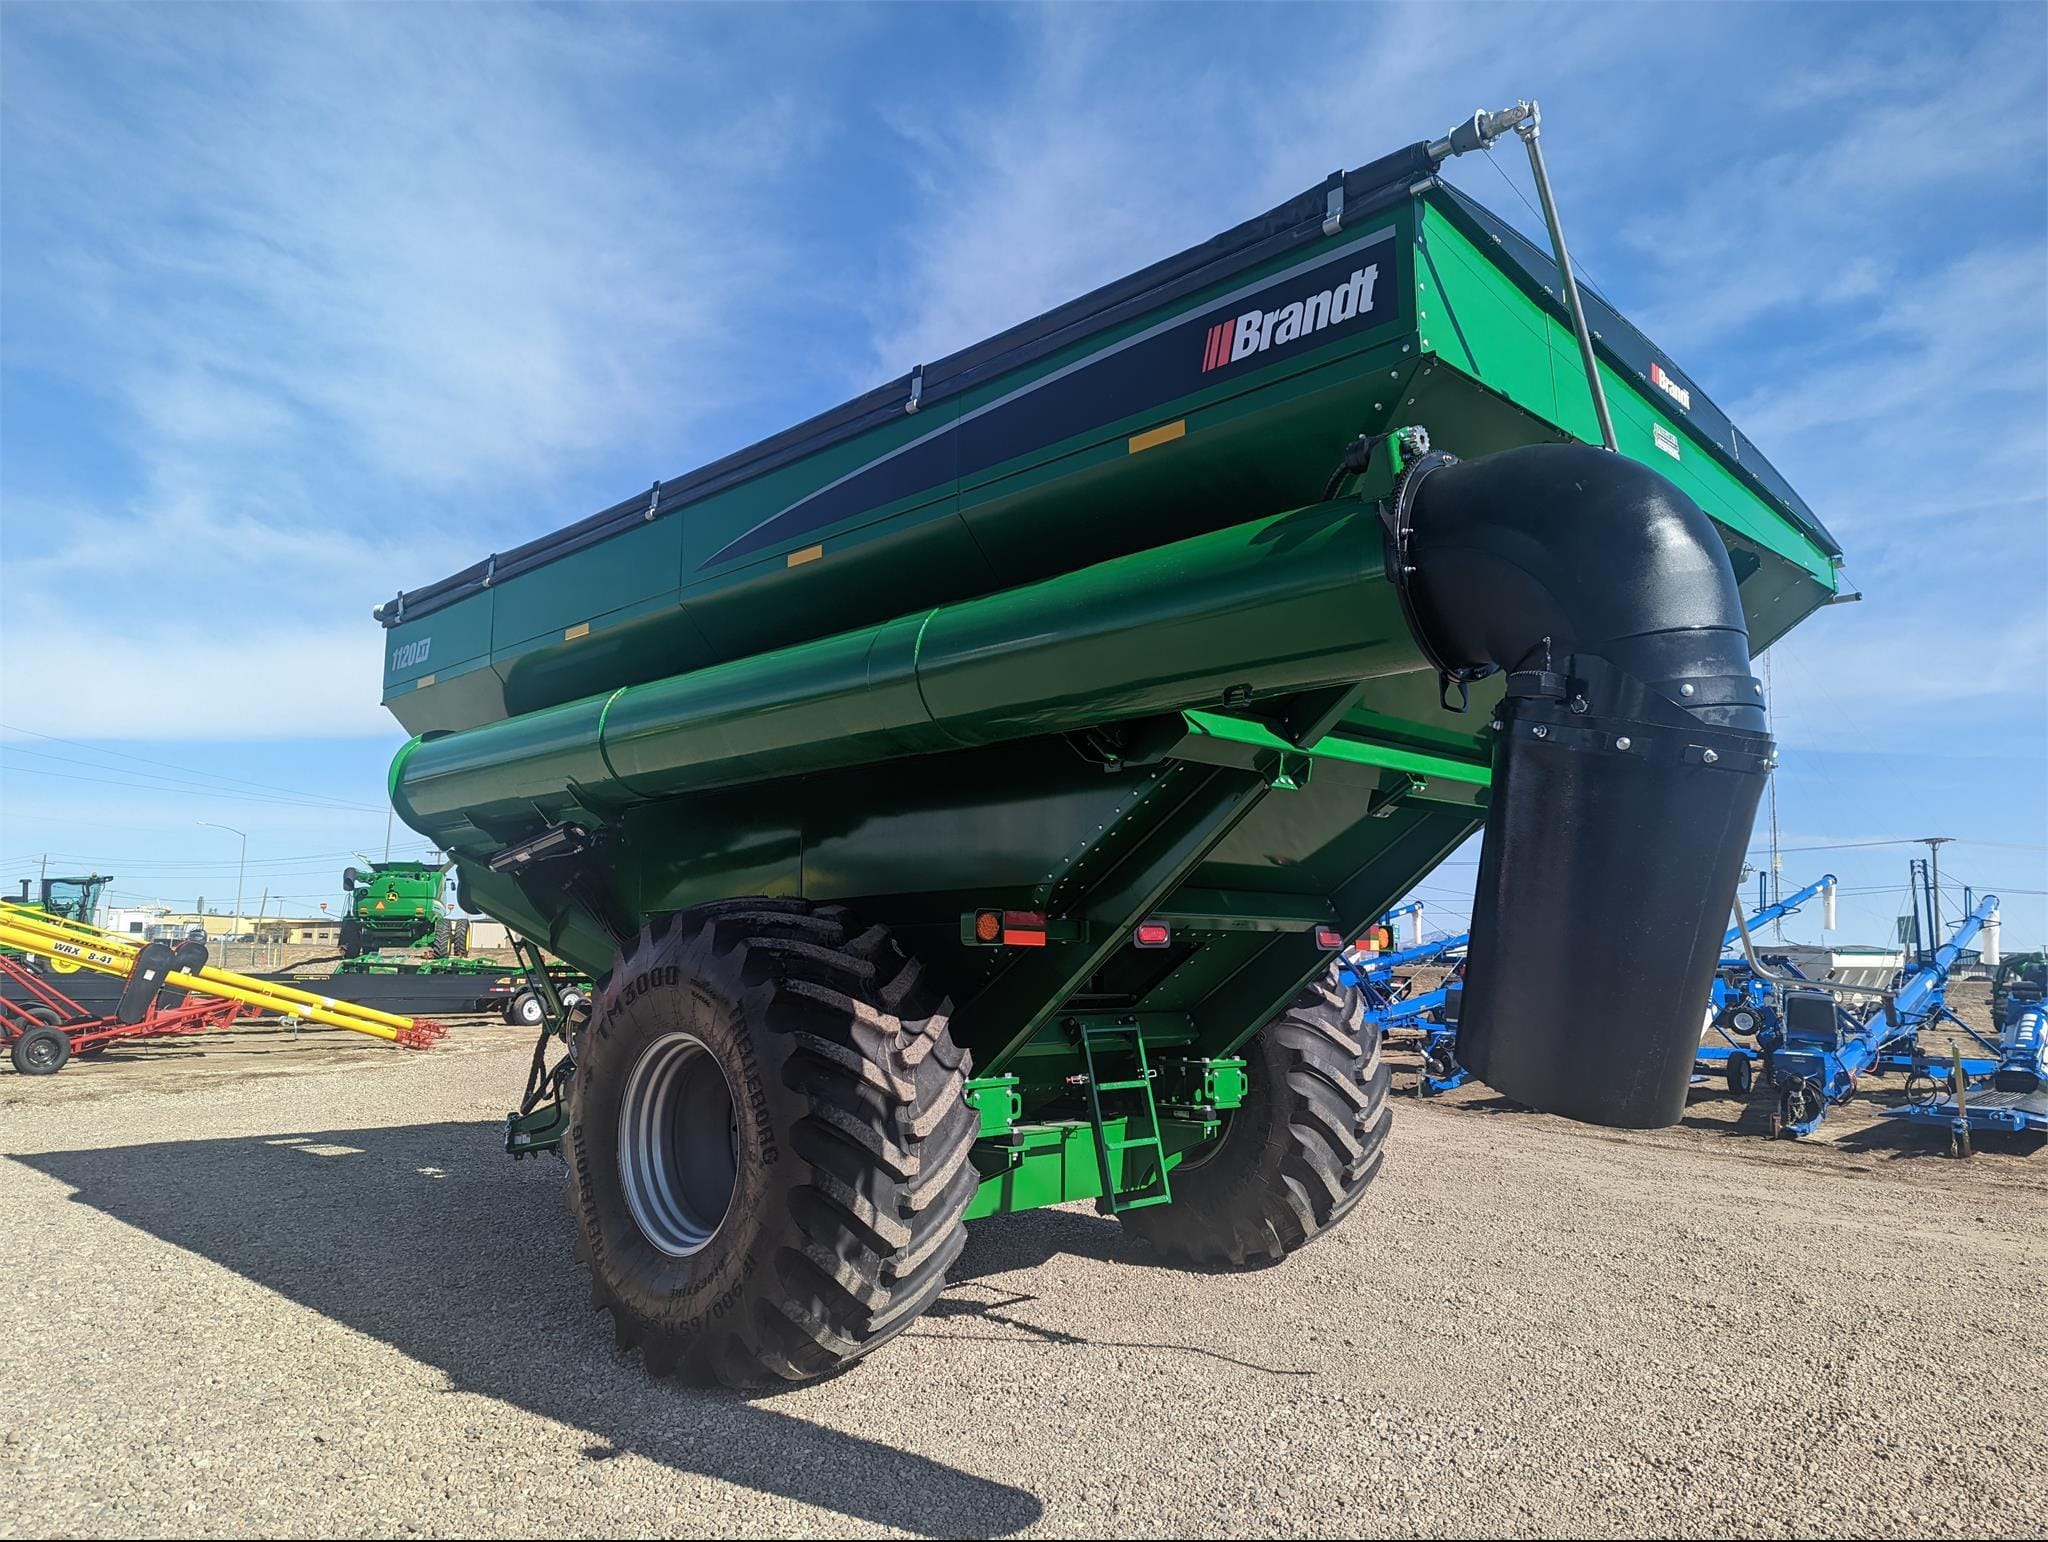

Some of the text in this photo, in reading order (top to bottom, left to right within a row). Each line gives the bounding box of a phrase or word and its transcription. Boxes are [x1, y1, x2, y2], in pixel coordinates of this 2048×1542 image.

[1231, 263, 1378, 363] Brandt
[1658, 367, 1691, 411] Brandt
[54, 942, 80, 956] WRX
[87, 952, 113, 964] 8-41
[623, 965, 681, 1006] 3000
